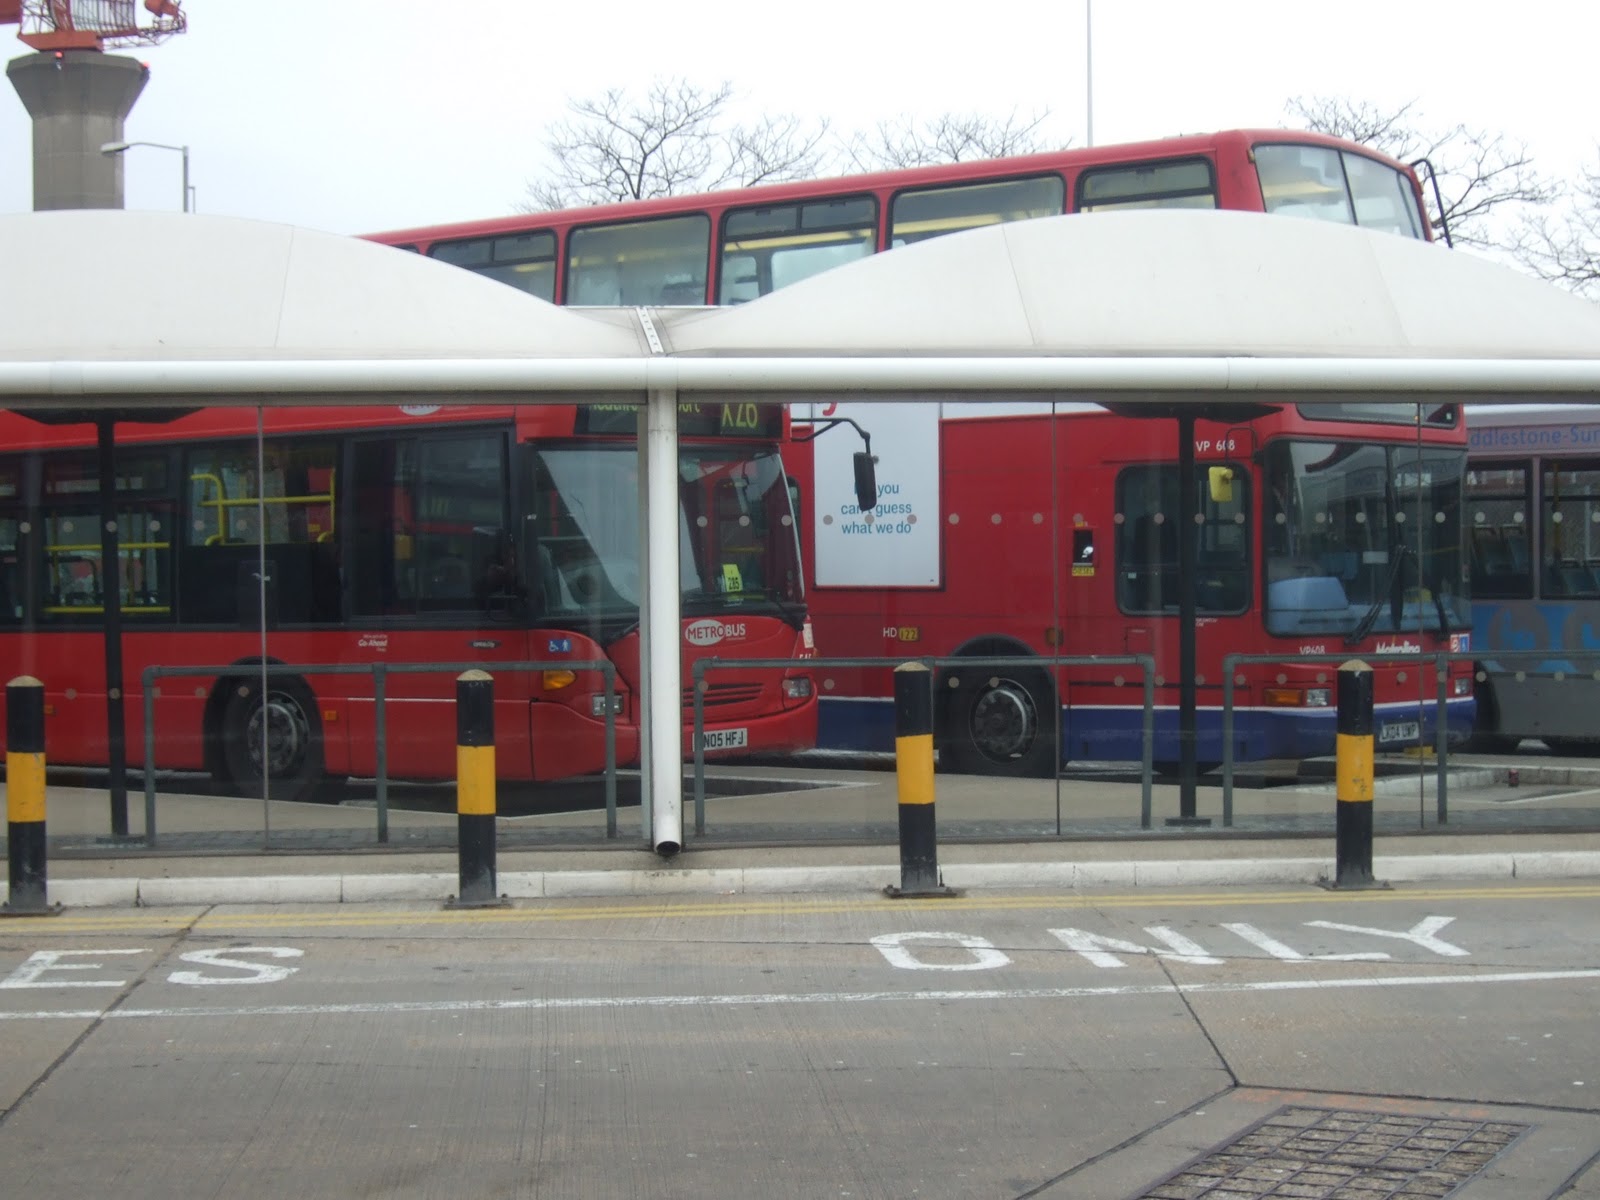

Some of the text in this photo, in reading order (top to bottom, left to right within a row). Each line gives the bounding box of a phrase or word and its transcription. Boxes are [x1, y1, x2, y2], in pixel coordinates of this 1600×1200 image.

[1196, 441, 1210, 452] VP
[877, 484, 900, 498] you
[875, 503, 912, 517] guess
[841, 520, 912, 534] what we do
[883, 627, 898, 638] HD
[703, 731, 744, 748] N05 HFJ
[868, 916, 1471, 972] ONLY
